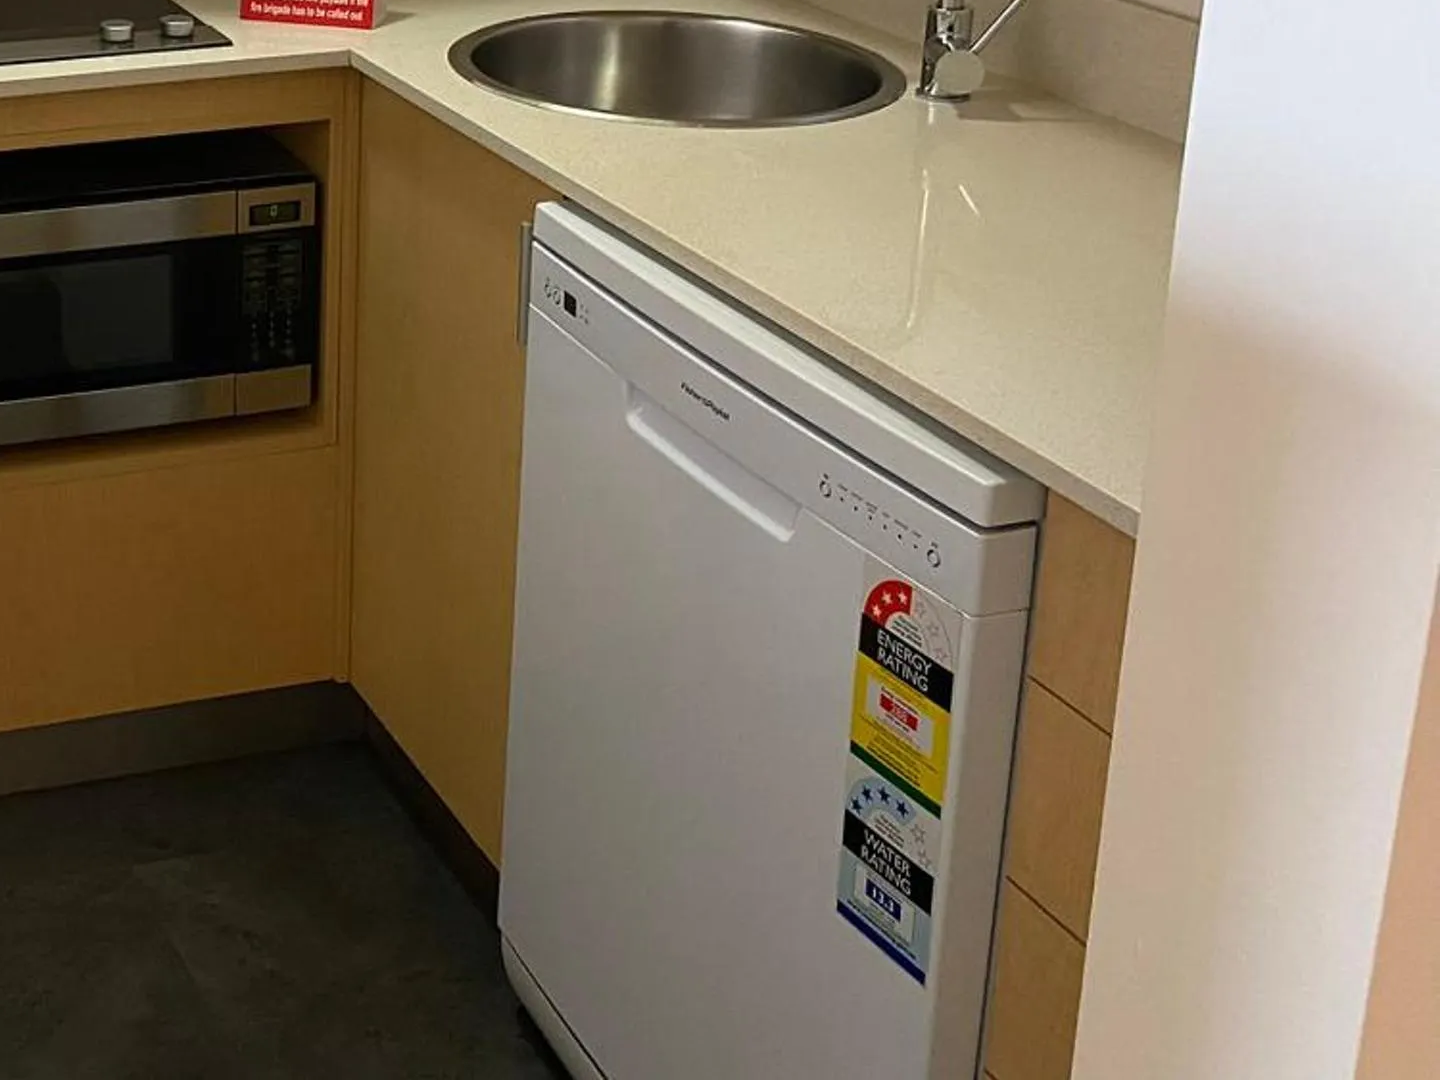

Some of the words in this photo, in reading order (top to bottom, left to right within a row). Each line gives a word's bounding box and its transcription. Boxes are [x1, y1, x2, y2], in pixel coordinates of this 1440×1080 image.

[877, 628, 932, 675] ENERGY
[877, 647, 928, 691] RATING
[861, 844, 911, 895] RATING
[864, 828, 911, 878] WATER
